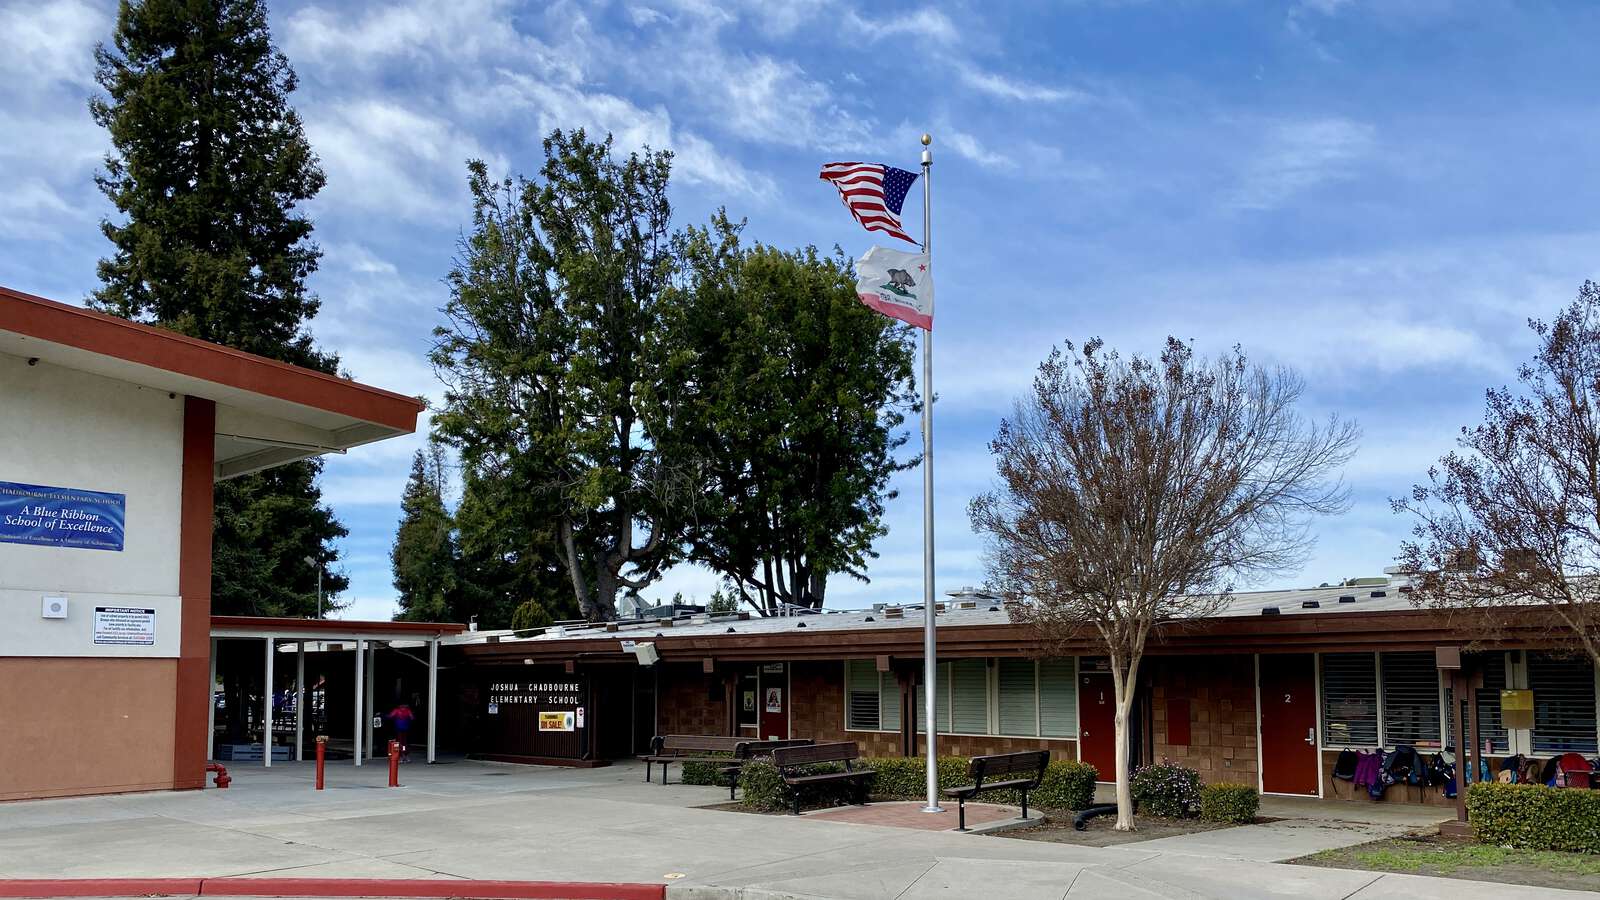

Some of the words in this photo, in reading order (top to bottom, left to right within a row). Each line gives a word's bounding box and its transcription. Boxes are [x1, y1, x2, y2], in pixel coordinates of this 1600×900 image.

[20, 505, 29, 515] A
[33, 506, 58, 518] Blue
[61, 508, 99, 521] Ribbon
[4, 514, 41, 527] School
[44, 518, 56, 531] of
[59, 519, 114, 534] Excellence
[490, 683, 519, 691] JOSHUA
[528, 683, 580, 692] CHADBOURNE
[490, 696, 538, 704] ELEMENTARY
[548, 696, 579, 705] SCHOOL
[1284, 694, 1291, 703] 2
